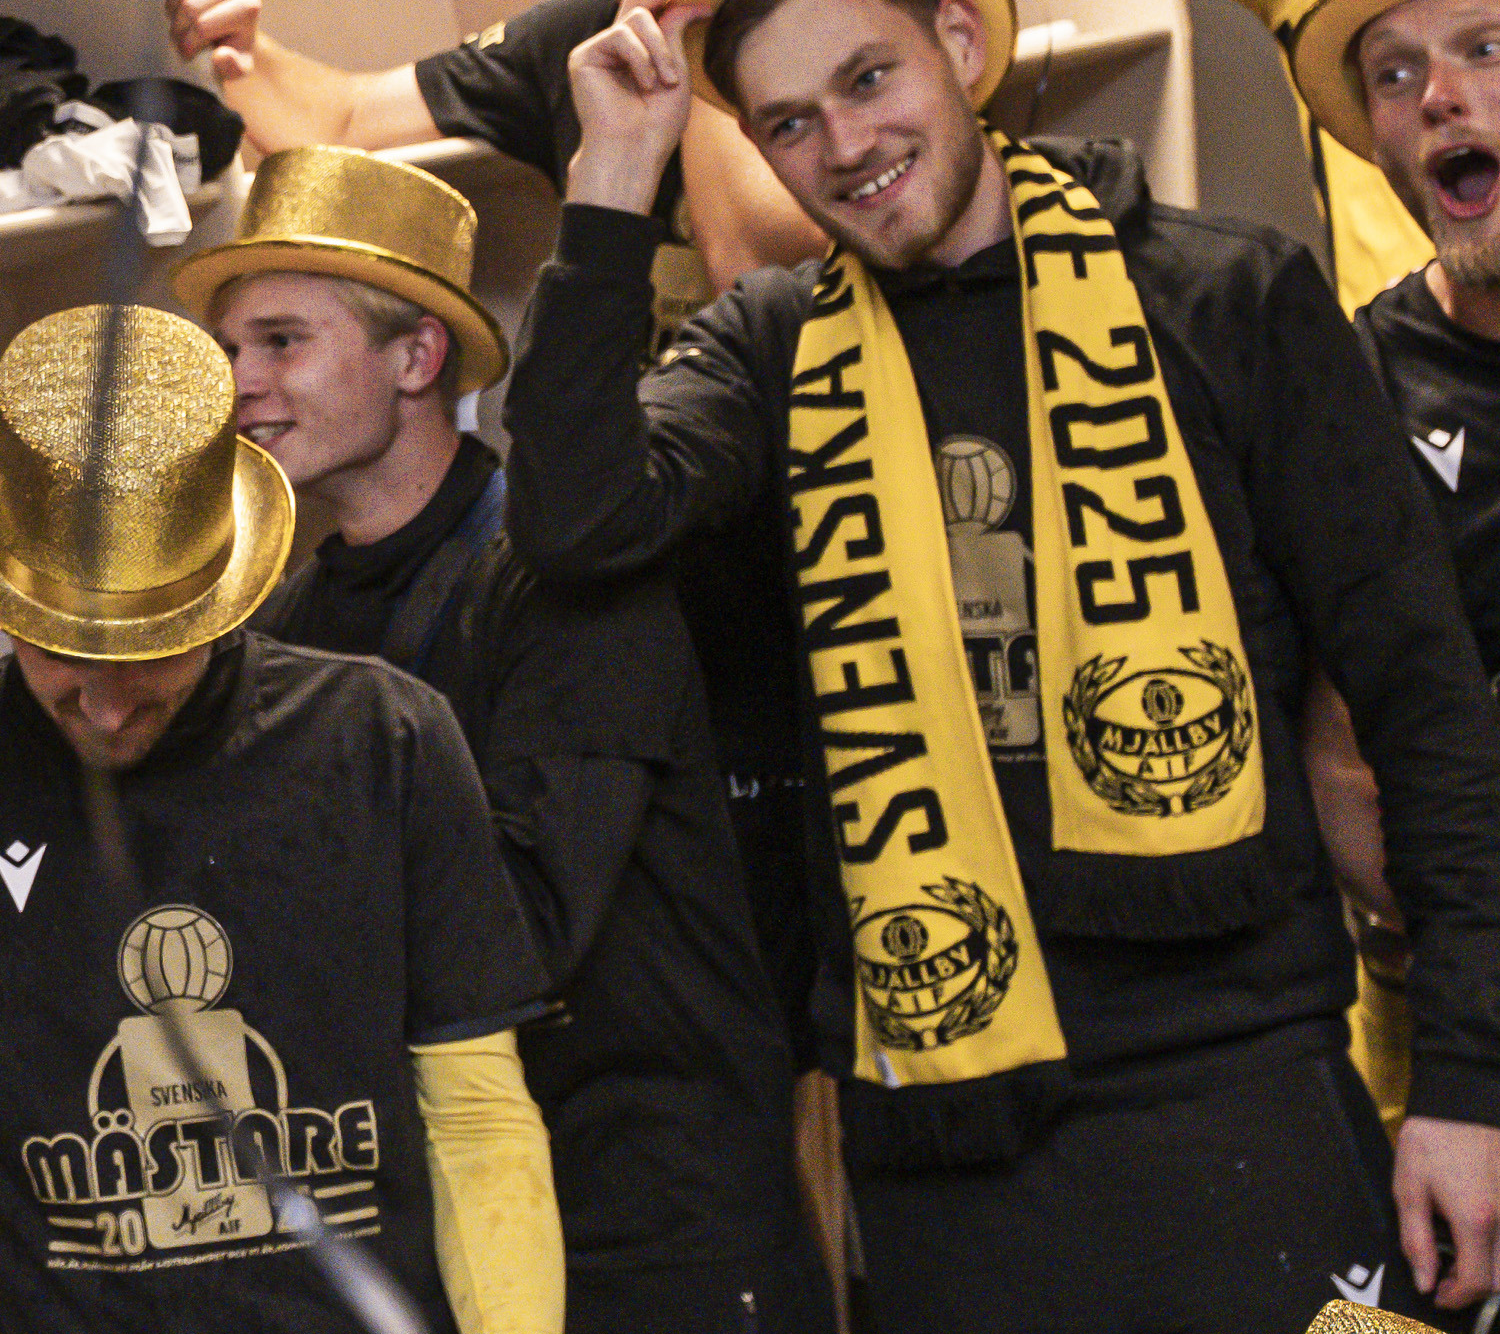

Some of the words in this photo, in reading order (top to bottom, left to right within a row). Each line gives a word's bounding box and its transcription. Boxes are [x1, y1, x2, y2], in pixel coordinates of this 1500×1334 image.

[1039, 323, 1199, 624] 2025
[788, 343, 949, 866] SVENSKA
[1099, 713, 1222, 755] MJÄLLBY
[1138, 751, 1195, 779] AIF
[150, 1079, 228, 1107] SVENSKA
[20, 1098, 380, 1205] MÄSTARE
[97, 1208, 147, 1257] 20
